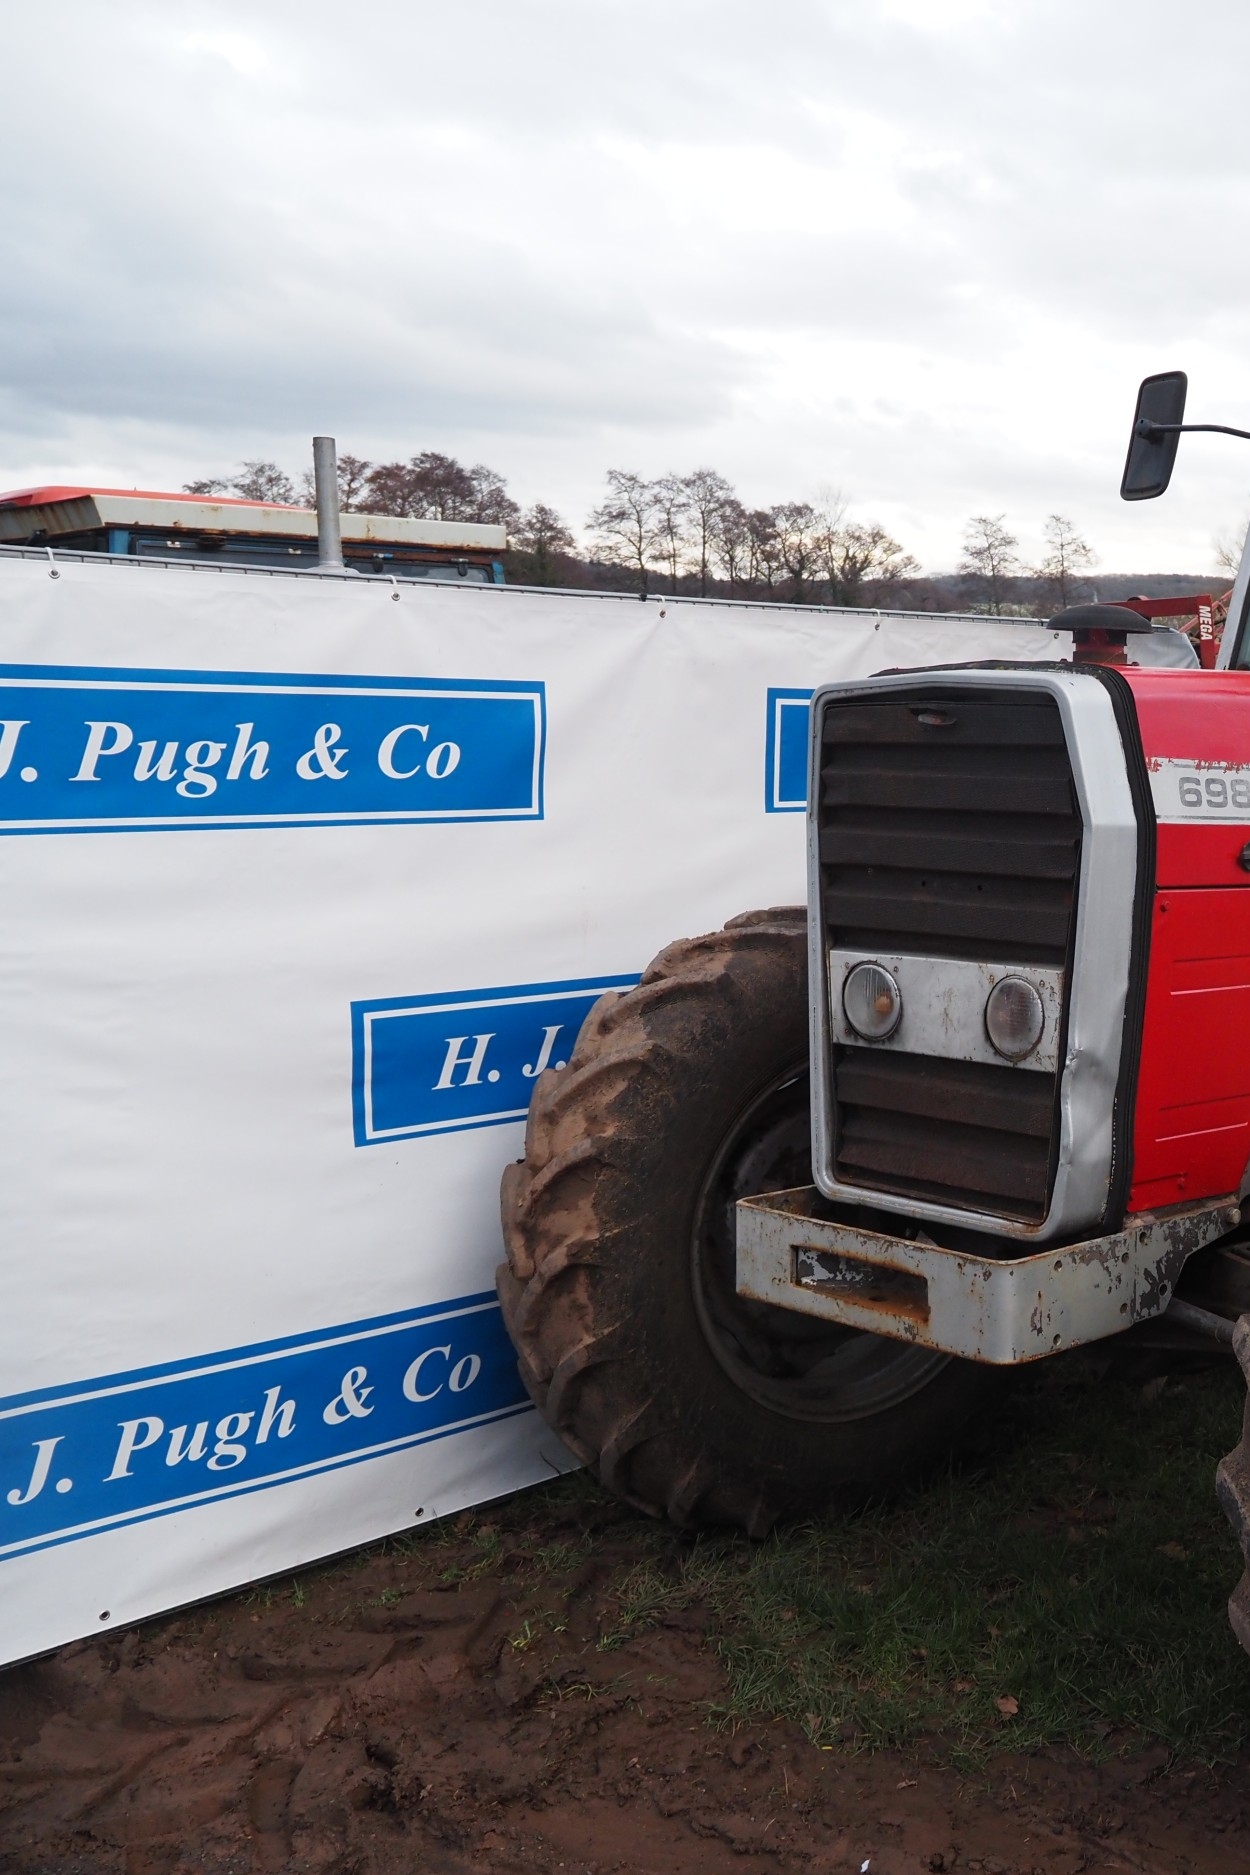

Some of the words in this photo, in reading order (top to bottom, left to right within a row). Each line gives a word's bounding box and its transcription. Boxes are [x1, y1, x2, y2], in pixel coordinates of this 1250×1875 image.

[1199, 605, 1214, 641] MEGA
[68, 721, 270, 799] Pugh
[296, 723, 349, 781] &
[377, 724, 461, 780] Co
[431, 1033, 501, 1091] H.
[521, 1024, 567, 1078] J.
[6, 1435, 73, 1506] J.
[103, 1385, 296, 1482] Pugh
[322, 1366, 375, 1425] &
[402, 1344, 482, 1403] Co
